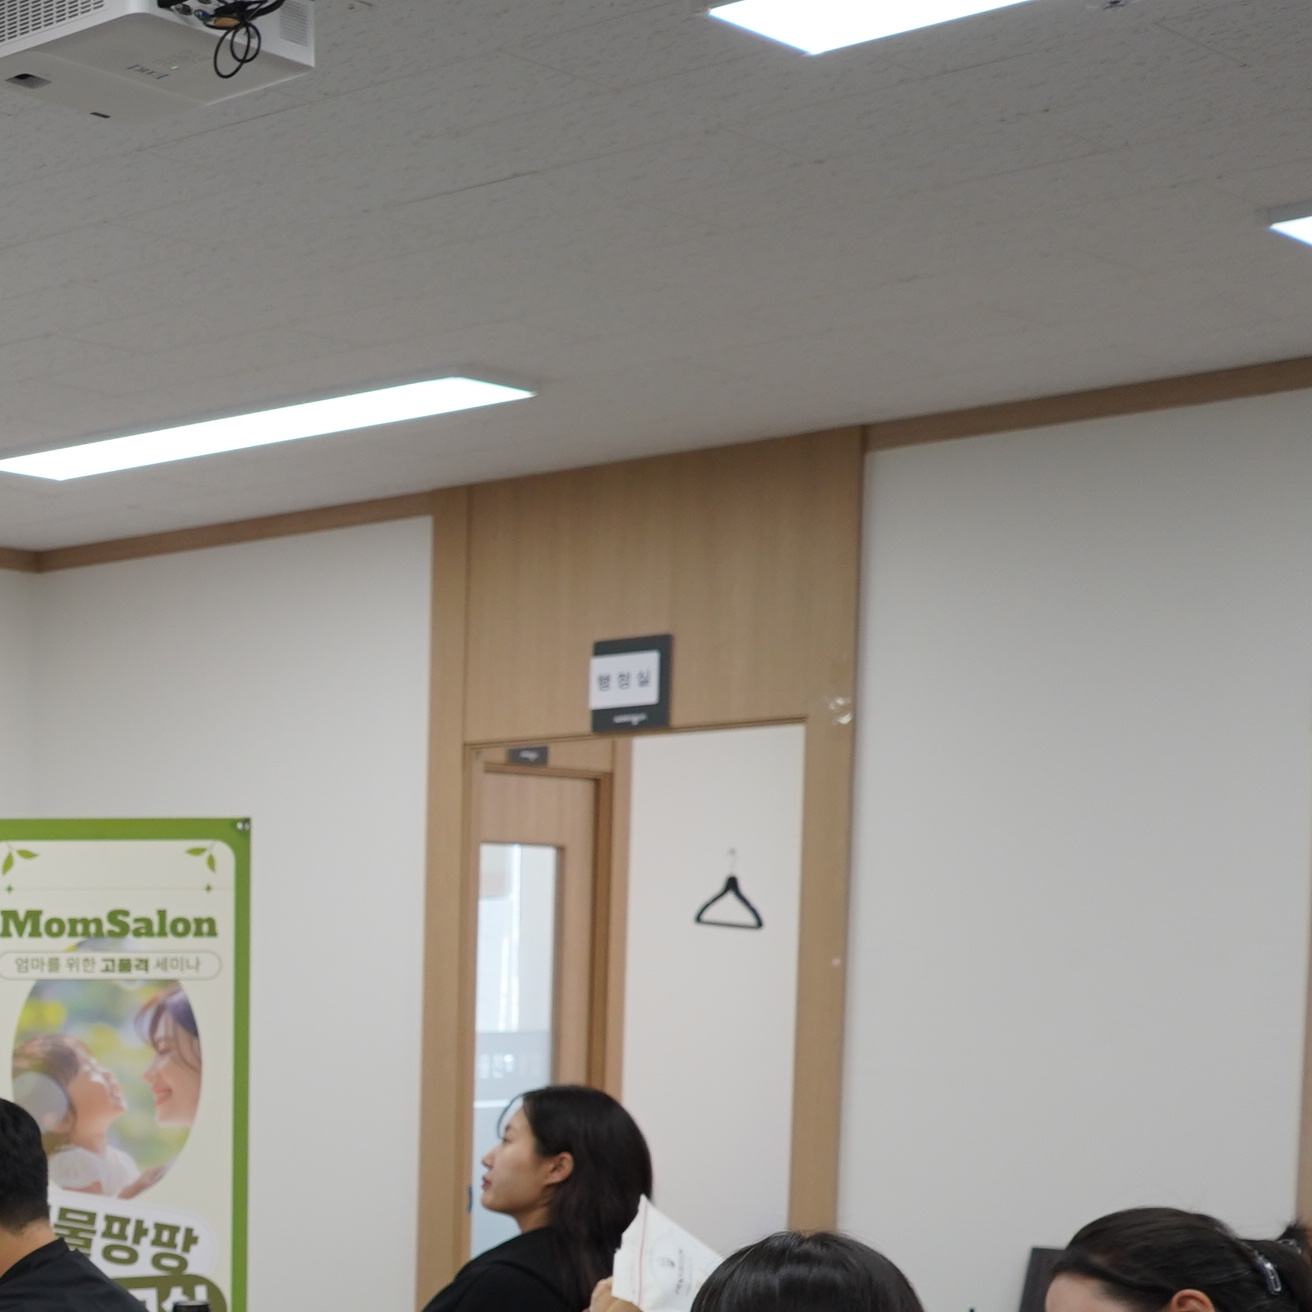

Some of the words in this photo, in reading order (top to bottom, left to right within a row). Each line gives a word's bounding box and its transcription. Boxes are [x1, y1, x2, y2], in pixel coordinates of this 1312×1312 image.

[0, 909, 218, 938] MomSalon
[14, 957, 61, 973] 엄마를
[66, 957, 96, 974] 위한
[101, 957, 149, 973] 고품격
[155, 956, 201, 973] 세미나
[52, 1206, 199, 1276] 물팡팡
